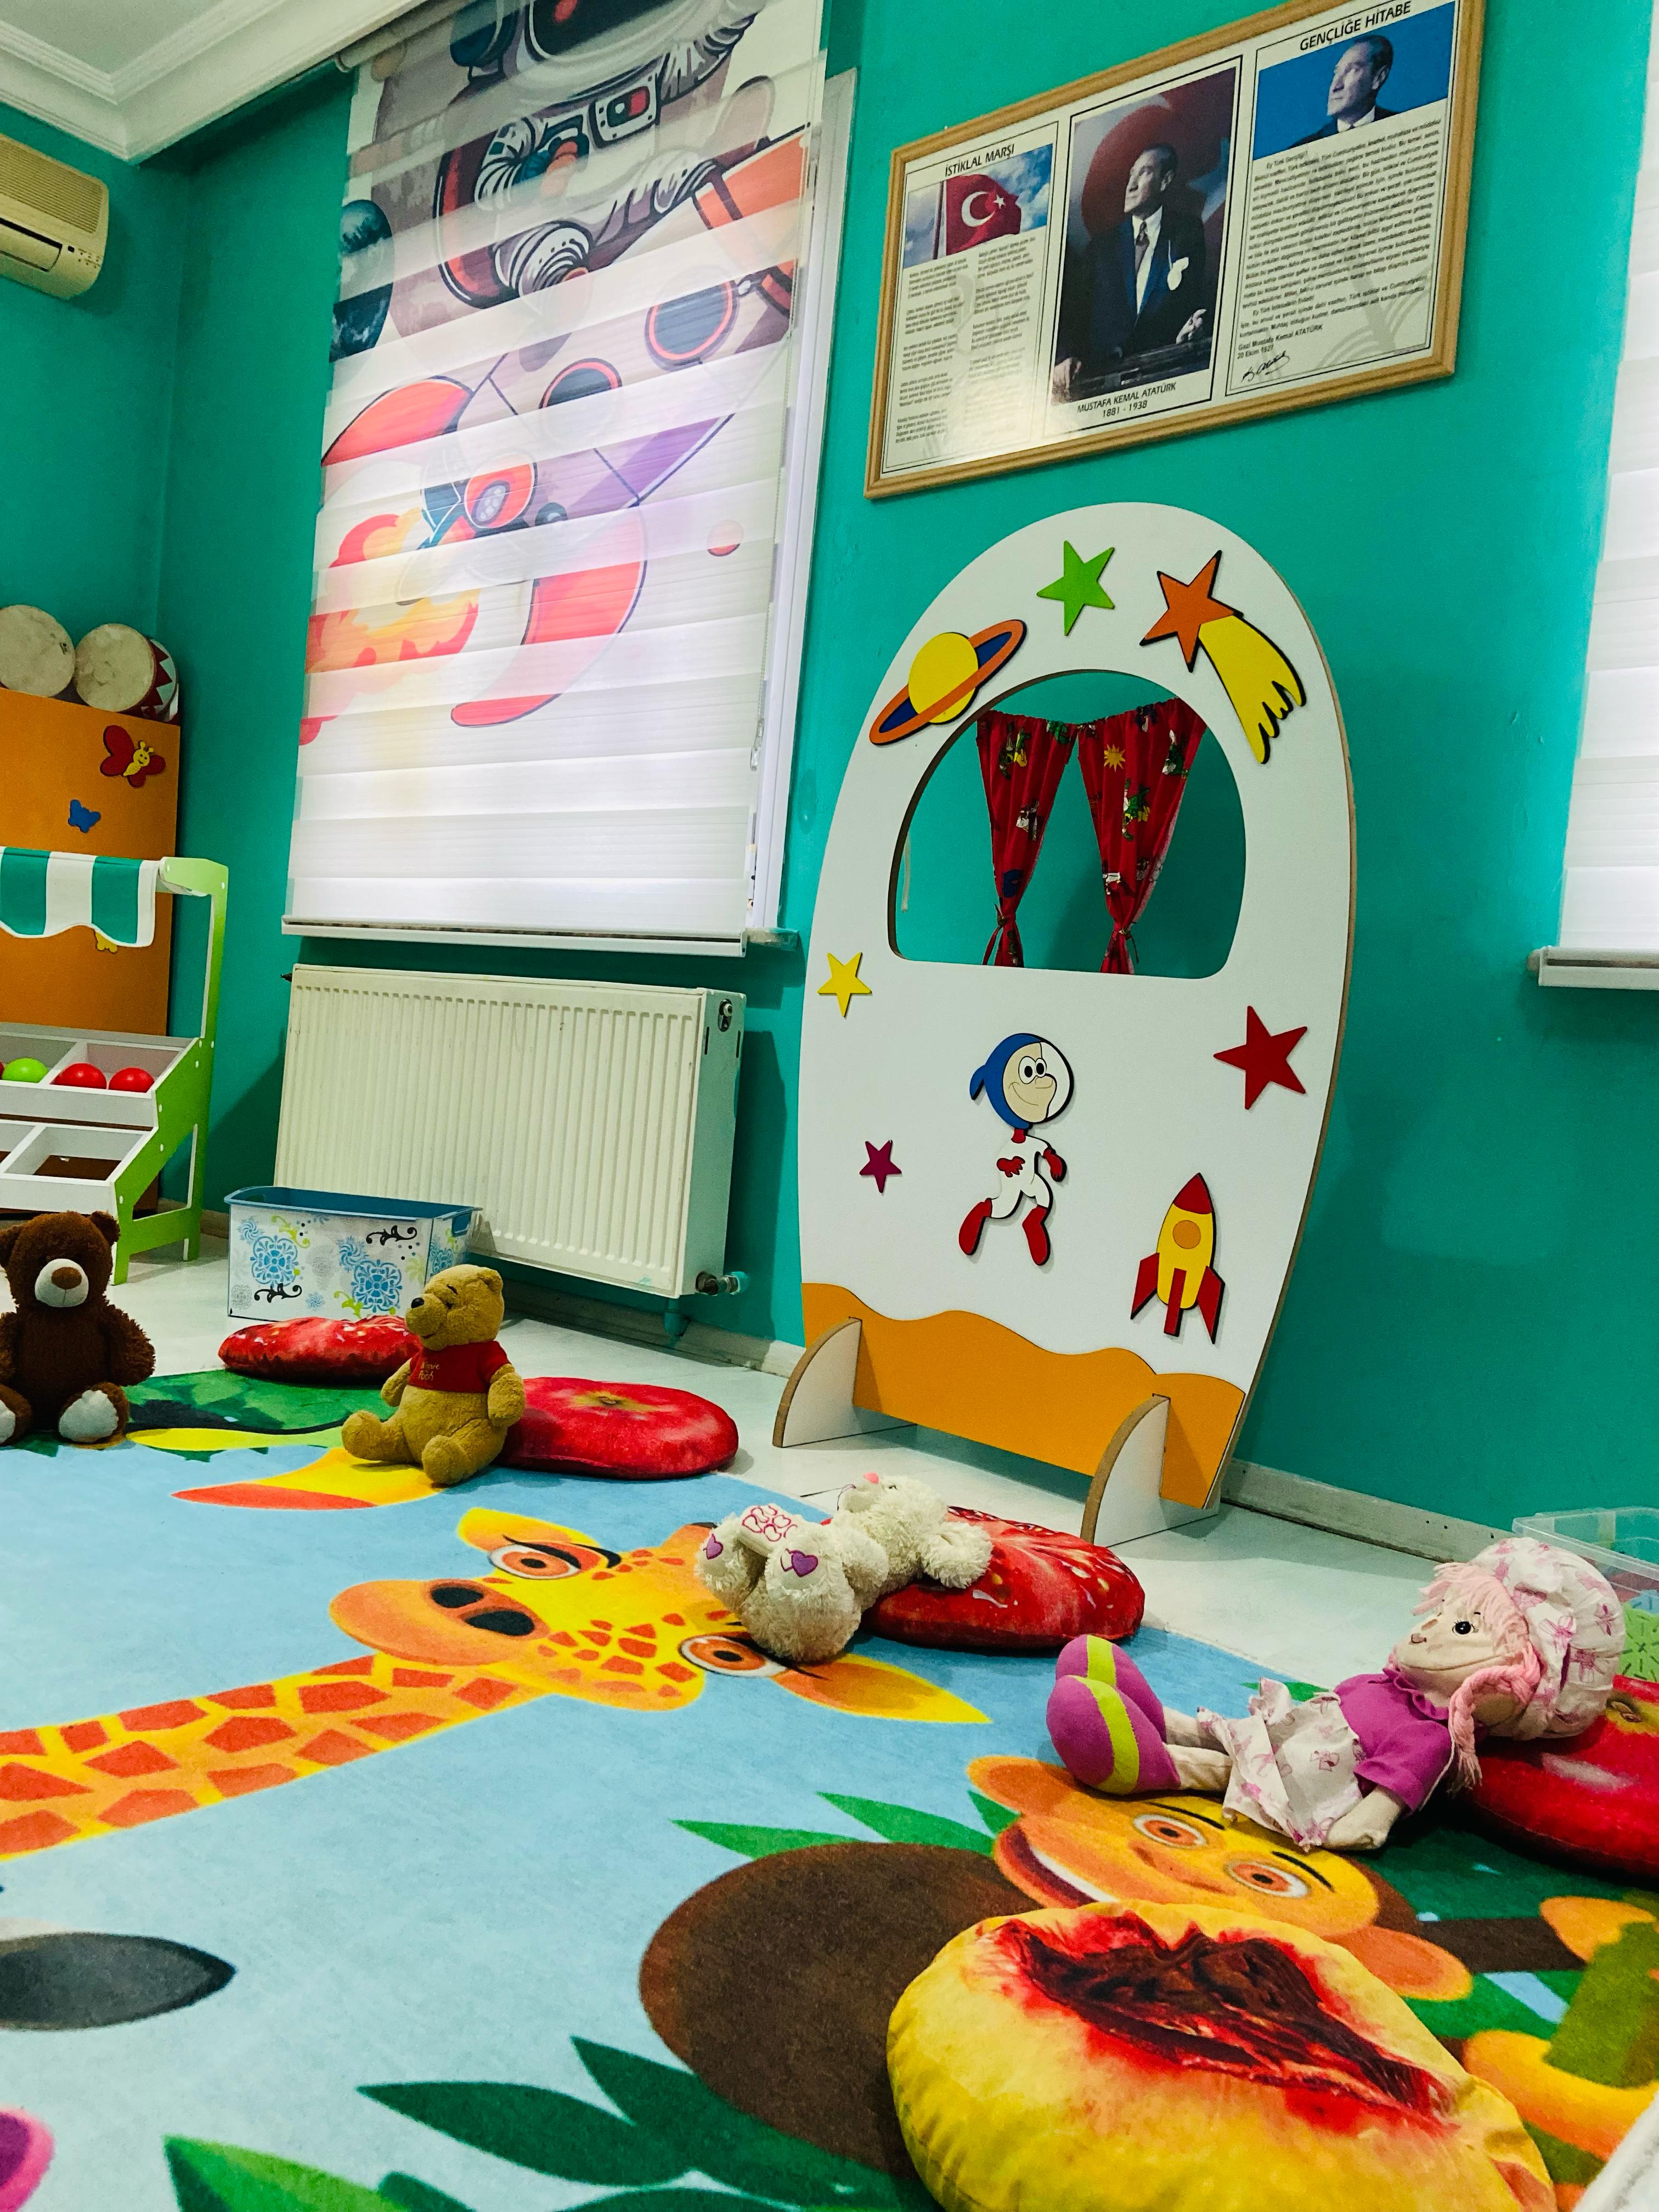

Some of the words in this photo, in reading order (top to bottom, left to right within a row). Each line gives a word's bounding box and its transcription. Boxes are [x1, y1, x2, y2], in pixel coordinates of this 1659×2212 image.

[1300, 18, 1361, 50] GENÇLİĞE
[1365, 1, 1411, 28] HİTABE
[985, 143, 1014, 163] MARŞI
[1252, 336, 1274, 347] Mustafa
[1276, 331, 1294, 341] Kemal
[1295, 324, 1323, 336] ATATÜRK
[1077, 398, 1111, 413] MUSTAFA
[1114, 391, 1139, 405] KEMAL
[1142, 381, 1176, 398] ATATÜRK
[1103, 406, 1120, 417] 1881
[1129, 399, 1148, 411] 1938
